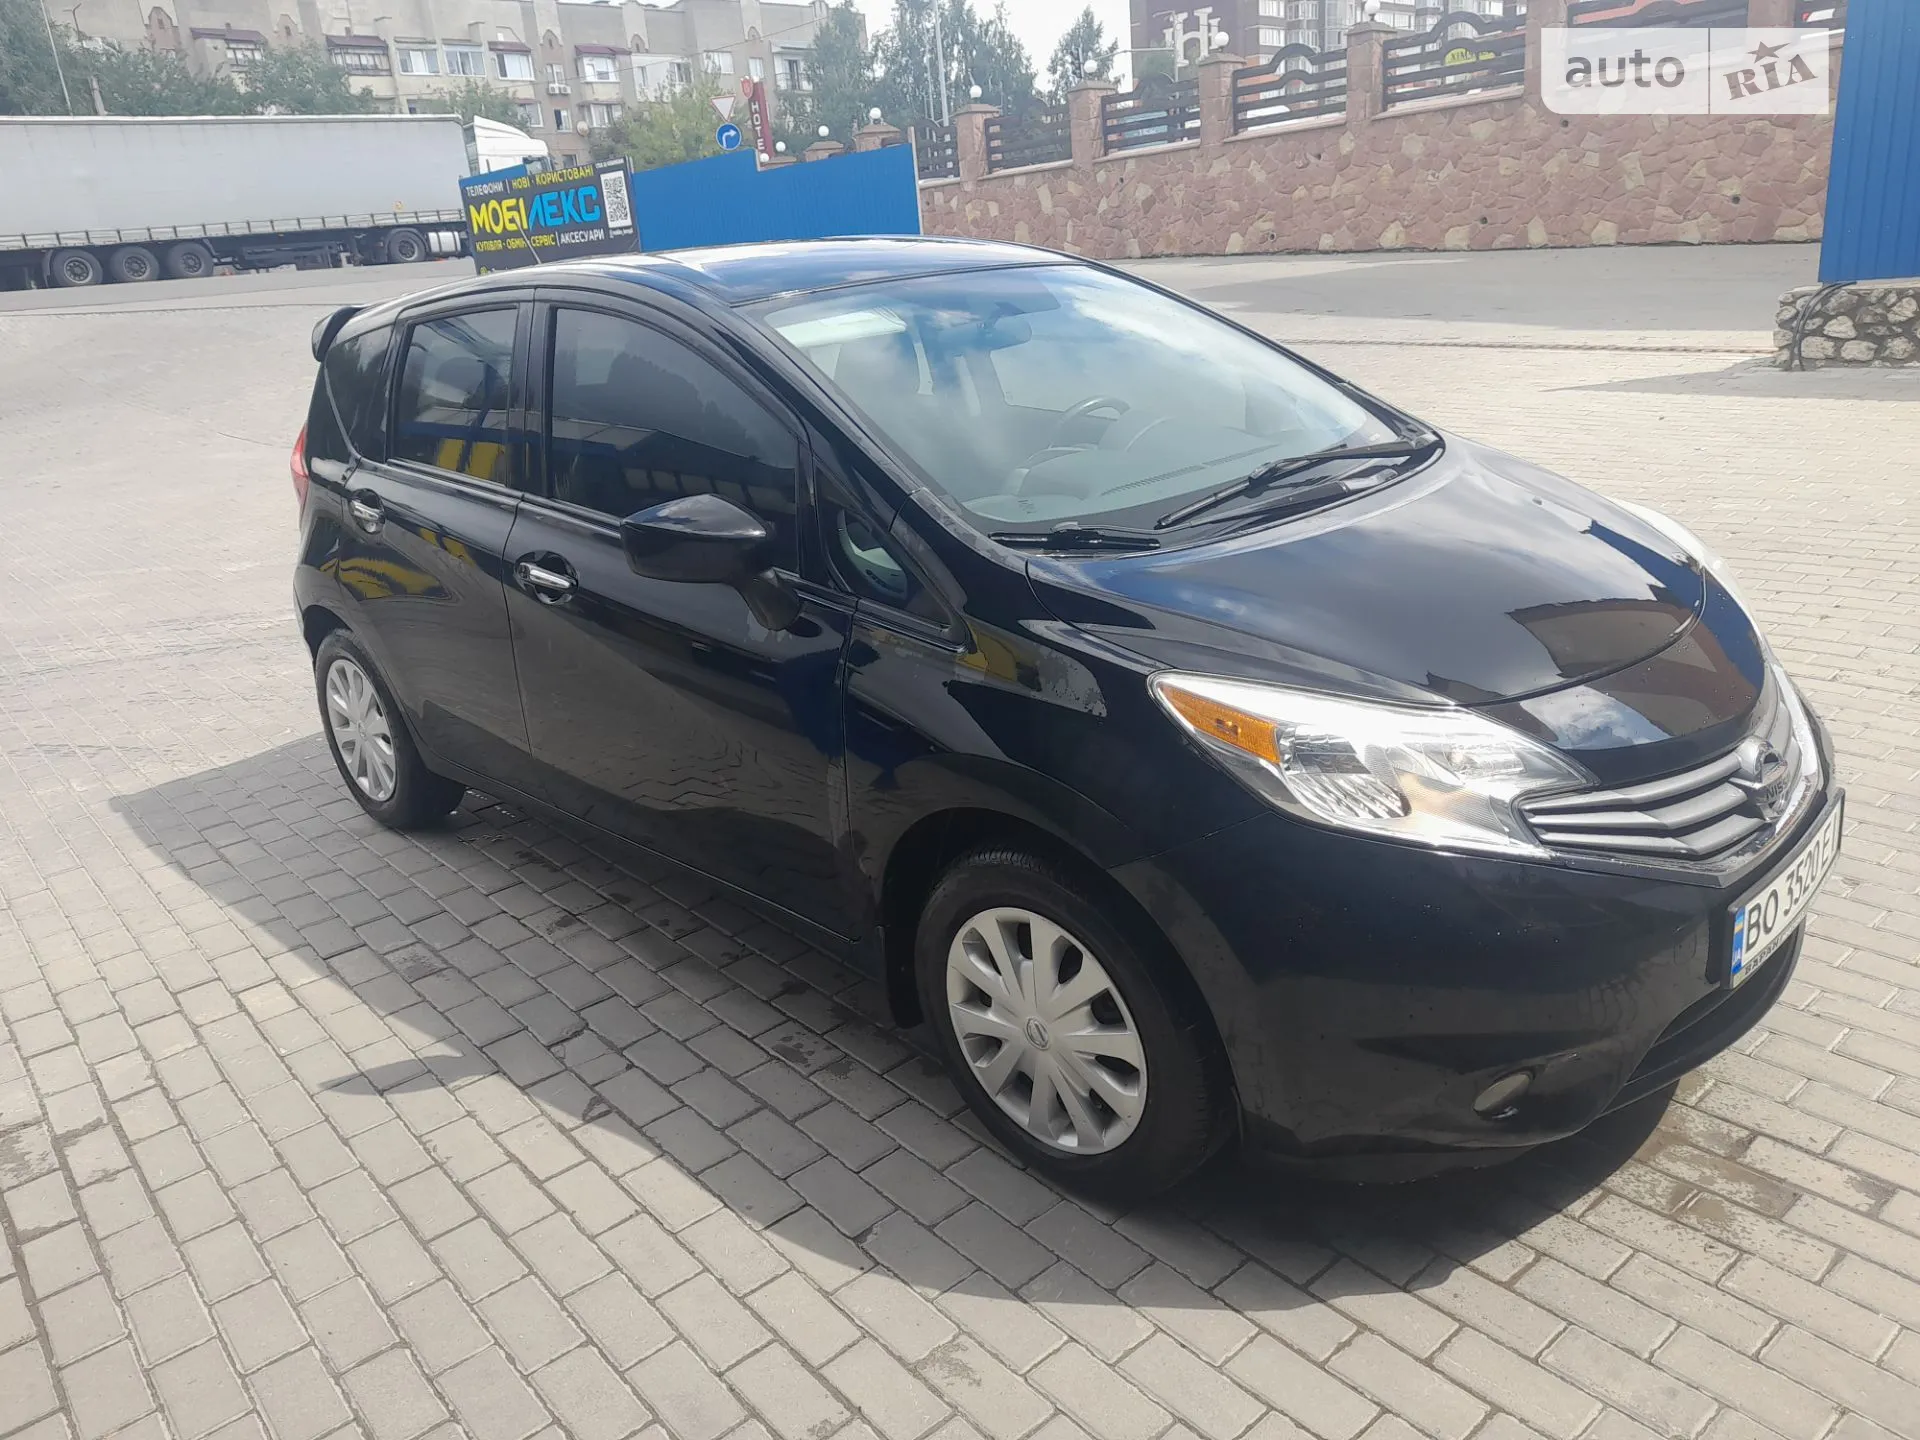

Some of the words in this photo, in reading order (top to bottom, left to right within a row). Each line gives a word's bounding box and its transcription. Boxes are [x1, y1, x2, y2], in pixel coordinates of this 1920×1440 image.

[751, 101, 766, 151] HOTE
[465, 180, 505, 197] ТЕЛЕФОНИ
[511, 176, 531, 189] НОВІ
[535, 164, 595, 186] КОРИСТОВАНІ
[475, 239, 503, 253] КУПІВЛЯ
[530, 234, 556, 248] СЕРВІС
[560, 228, 605, 244] АКСЕСУАРИ
[1745, 888, 1779, 955] BO
[1784, 839, 1820, 917] 3520
